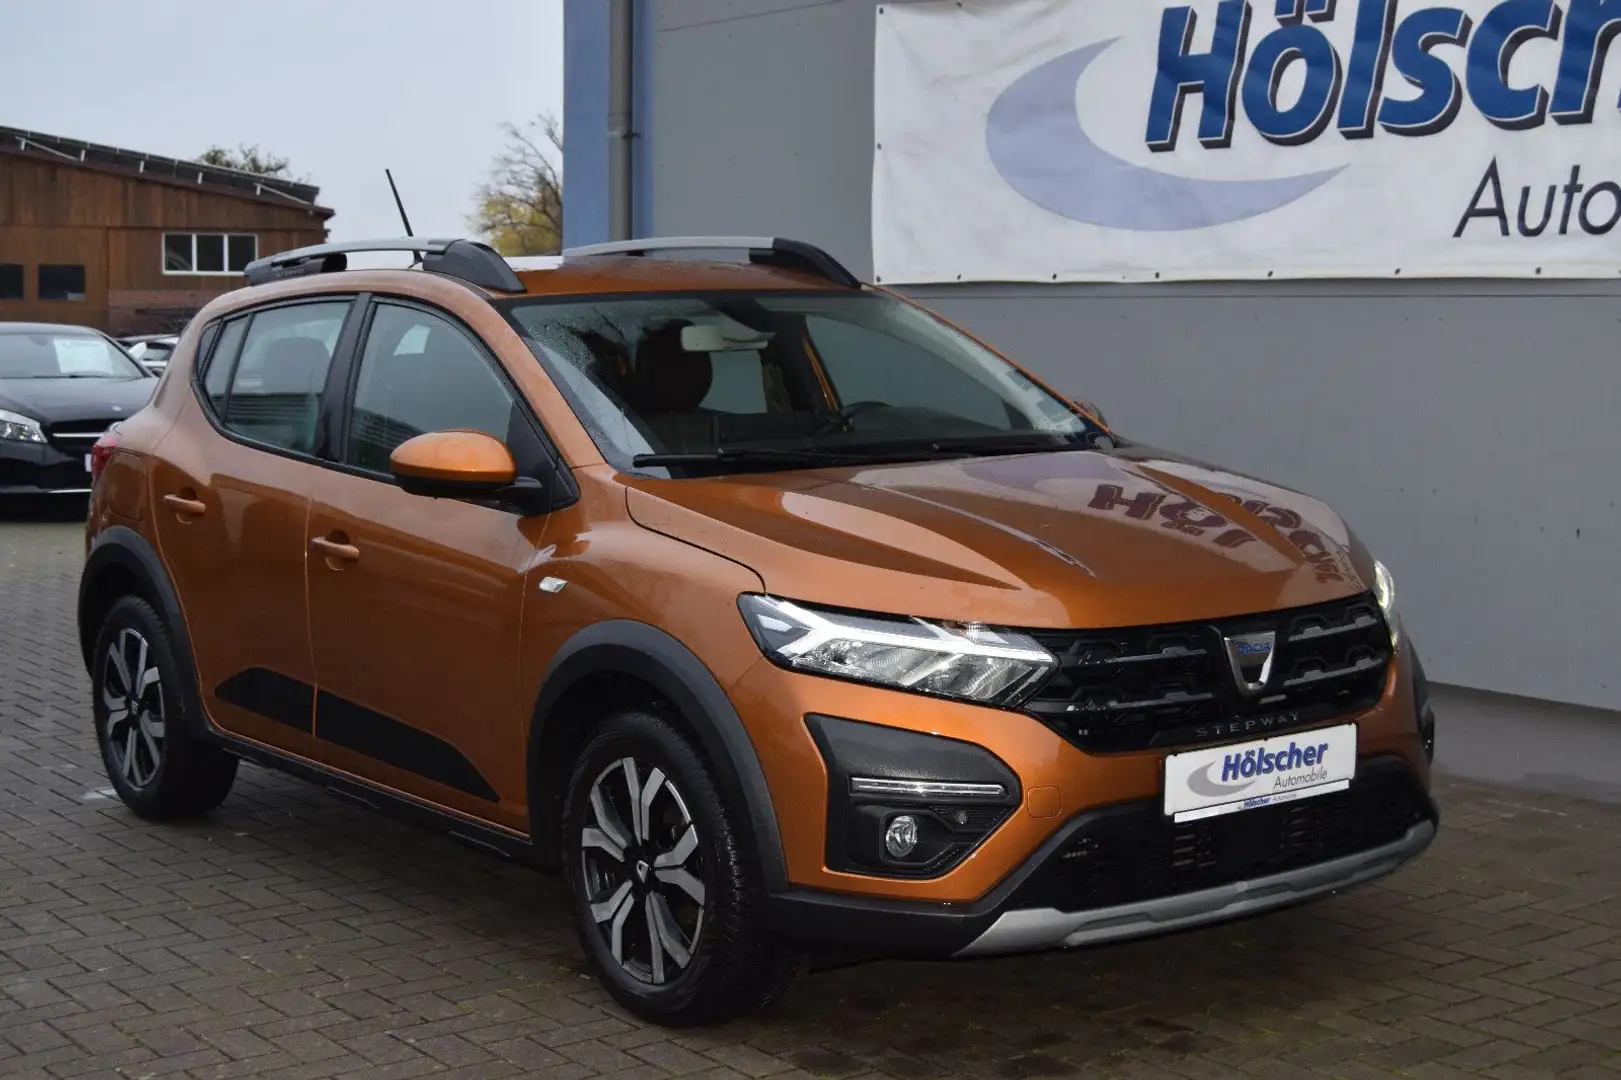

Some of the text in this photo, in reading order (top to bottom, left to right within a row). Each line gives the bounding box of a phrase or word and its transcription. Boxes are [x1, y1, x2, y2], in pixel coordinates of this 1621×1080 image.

[1452, 154, 1621, 238] Auto
[1196, 711, 1299, 737] STEPWAY
[1221, 741, 1329, 782] Hölscher
[1272, 765, 1328, 790] Automobile
